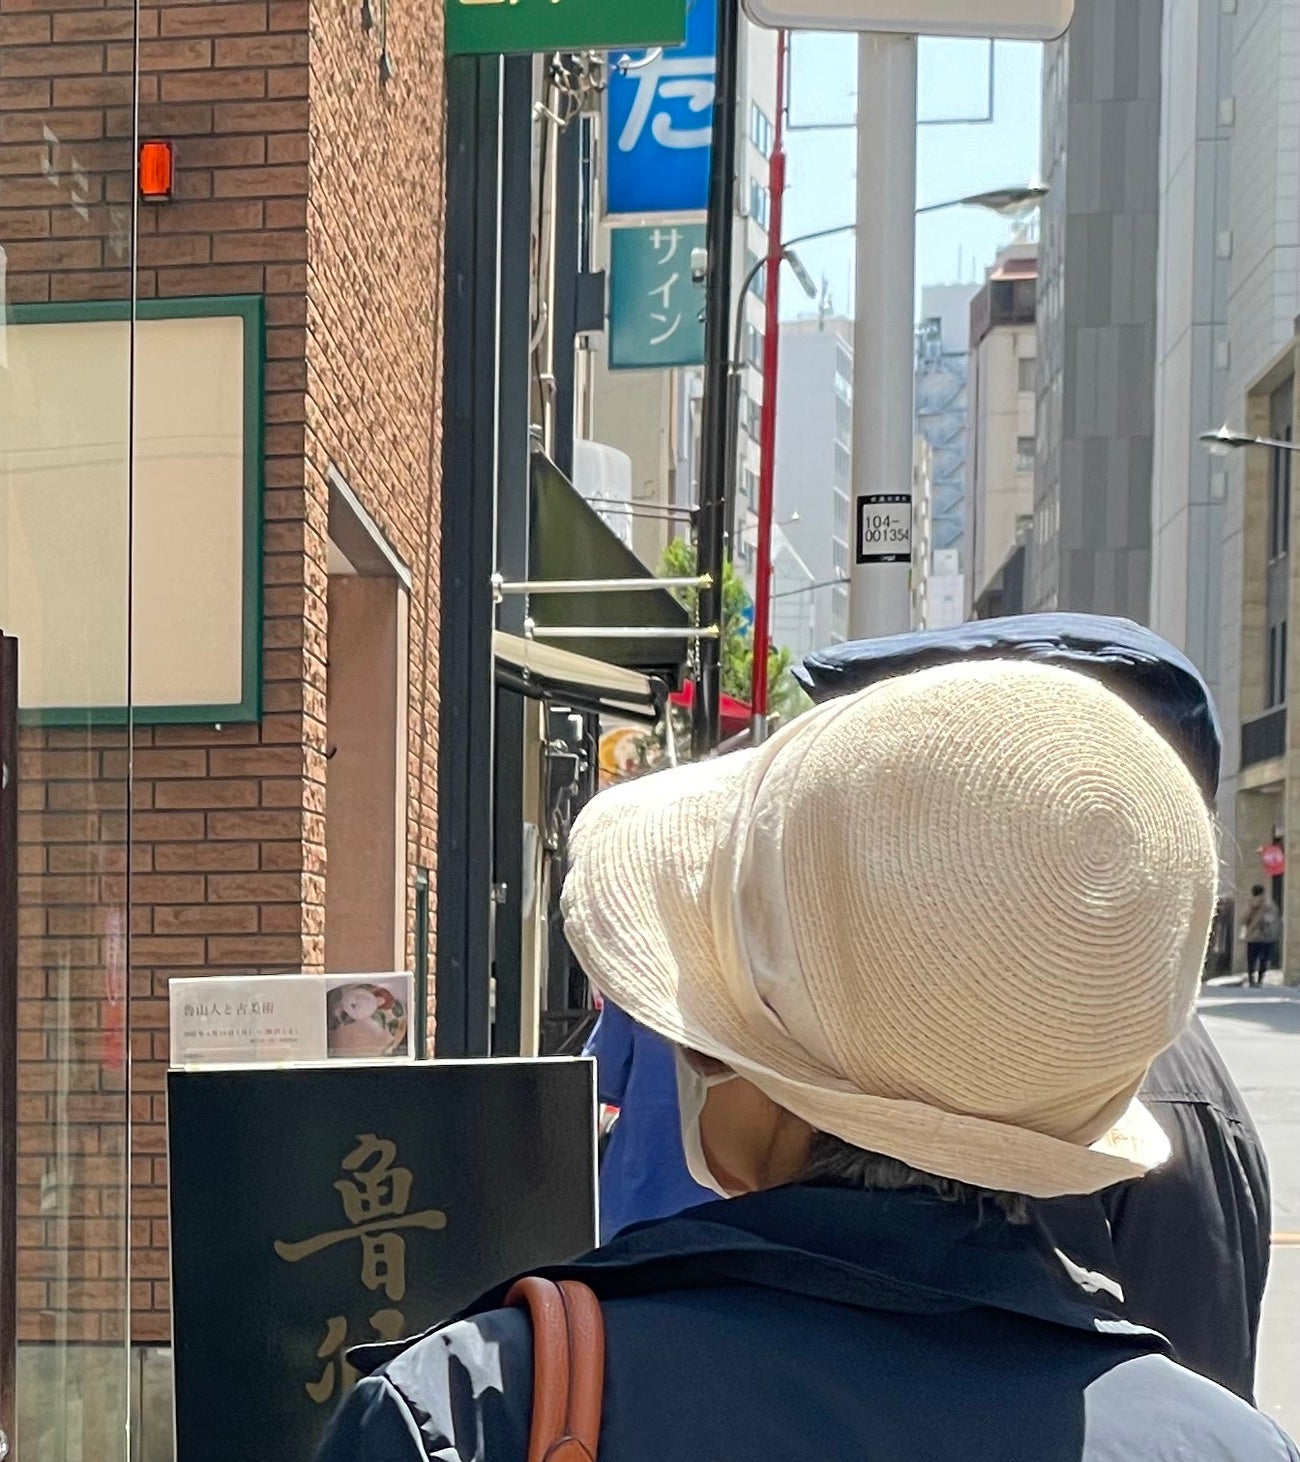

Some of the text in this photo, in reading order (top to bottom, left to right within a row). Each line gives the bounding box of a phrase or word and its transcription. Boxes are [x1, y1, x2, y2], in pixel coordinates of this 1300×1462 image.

[648, 228, 684, 345] サイン
[865, 515, 900, 529] 104-
[865, 529, 909, 542] 001354
